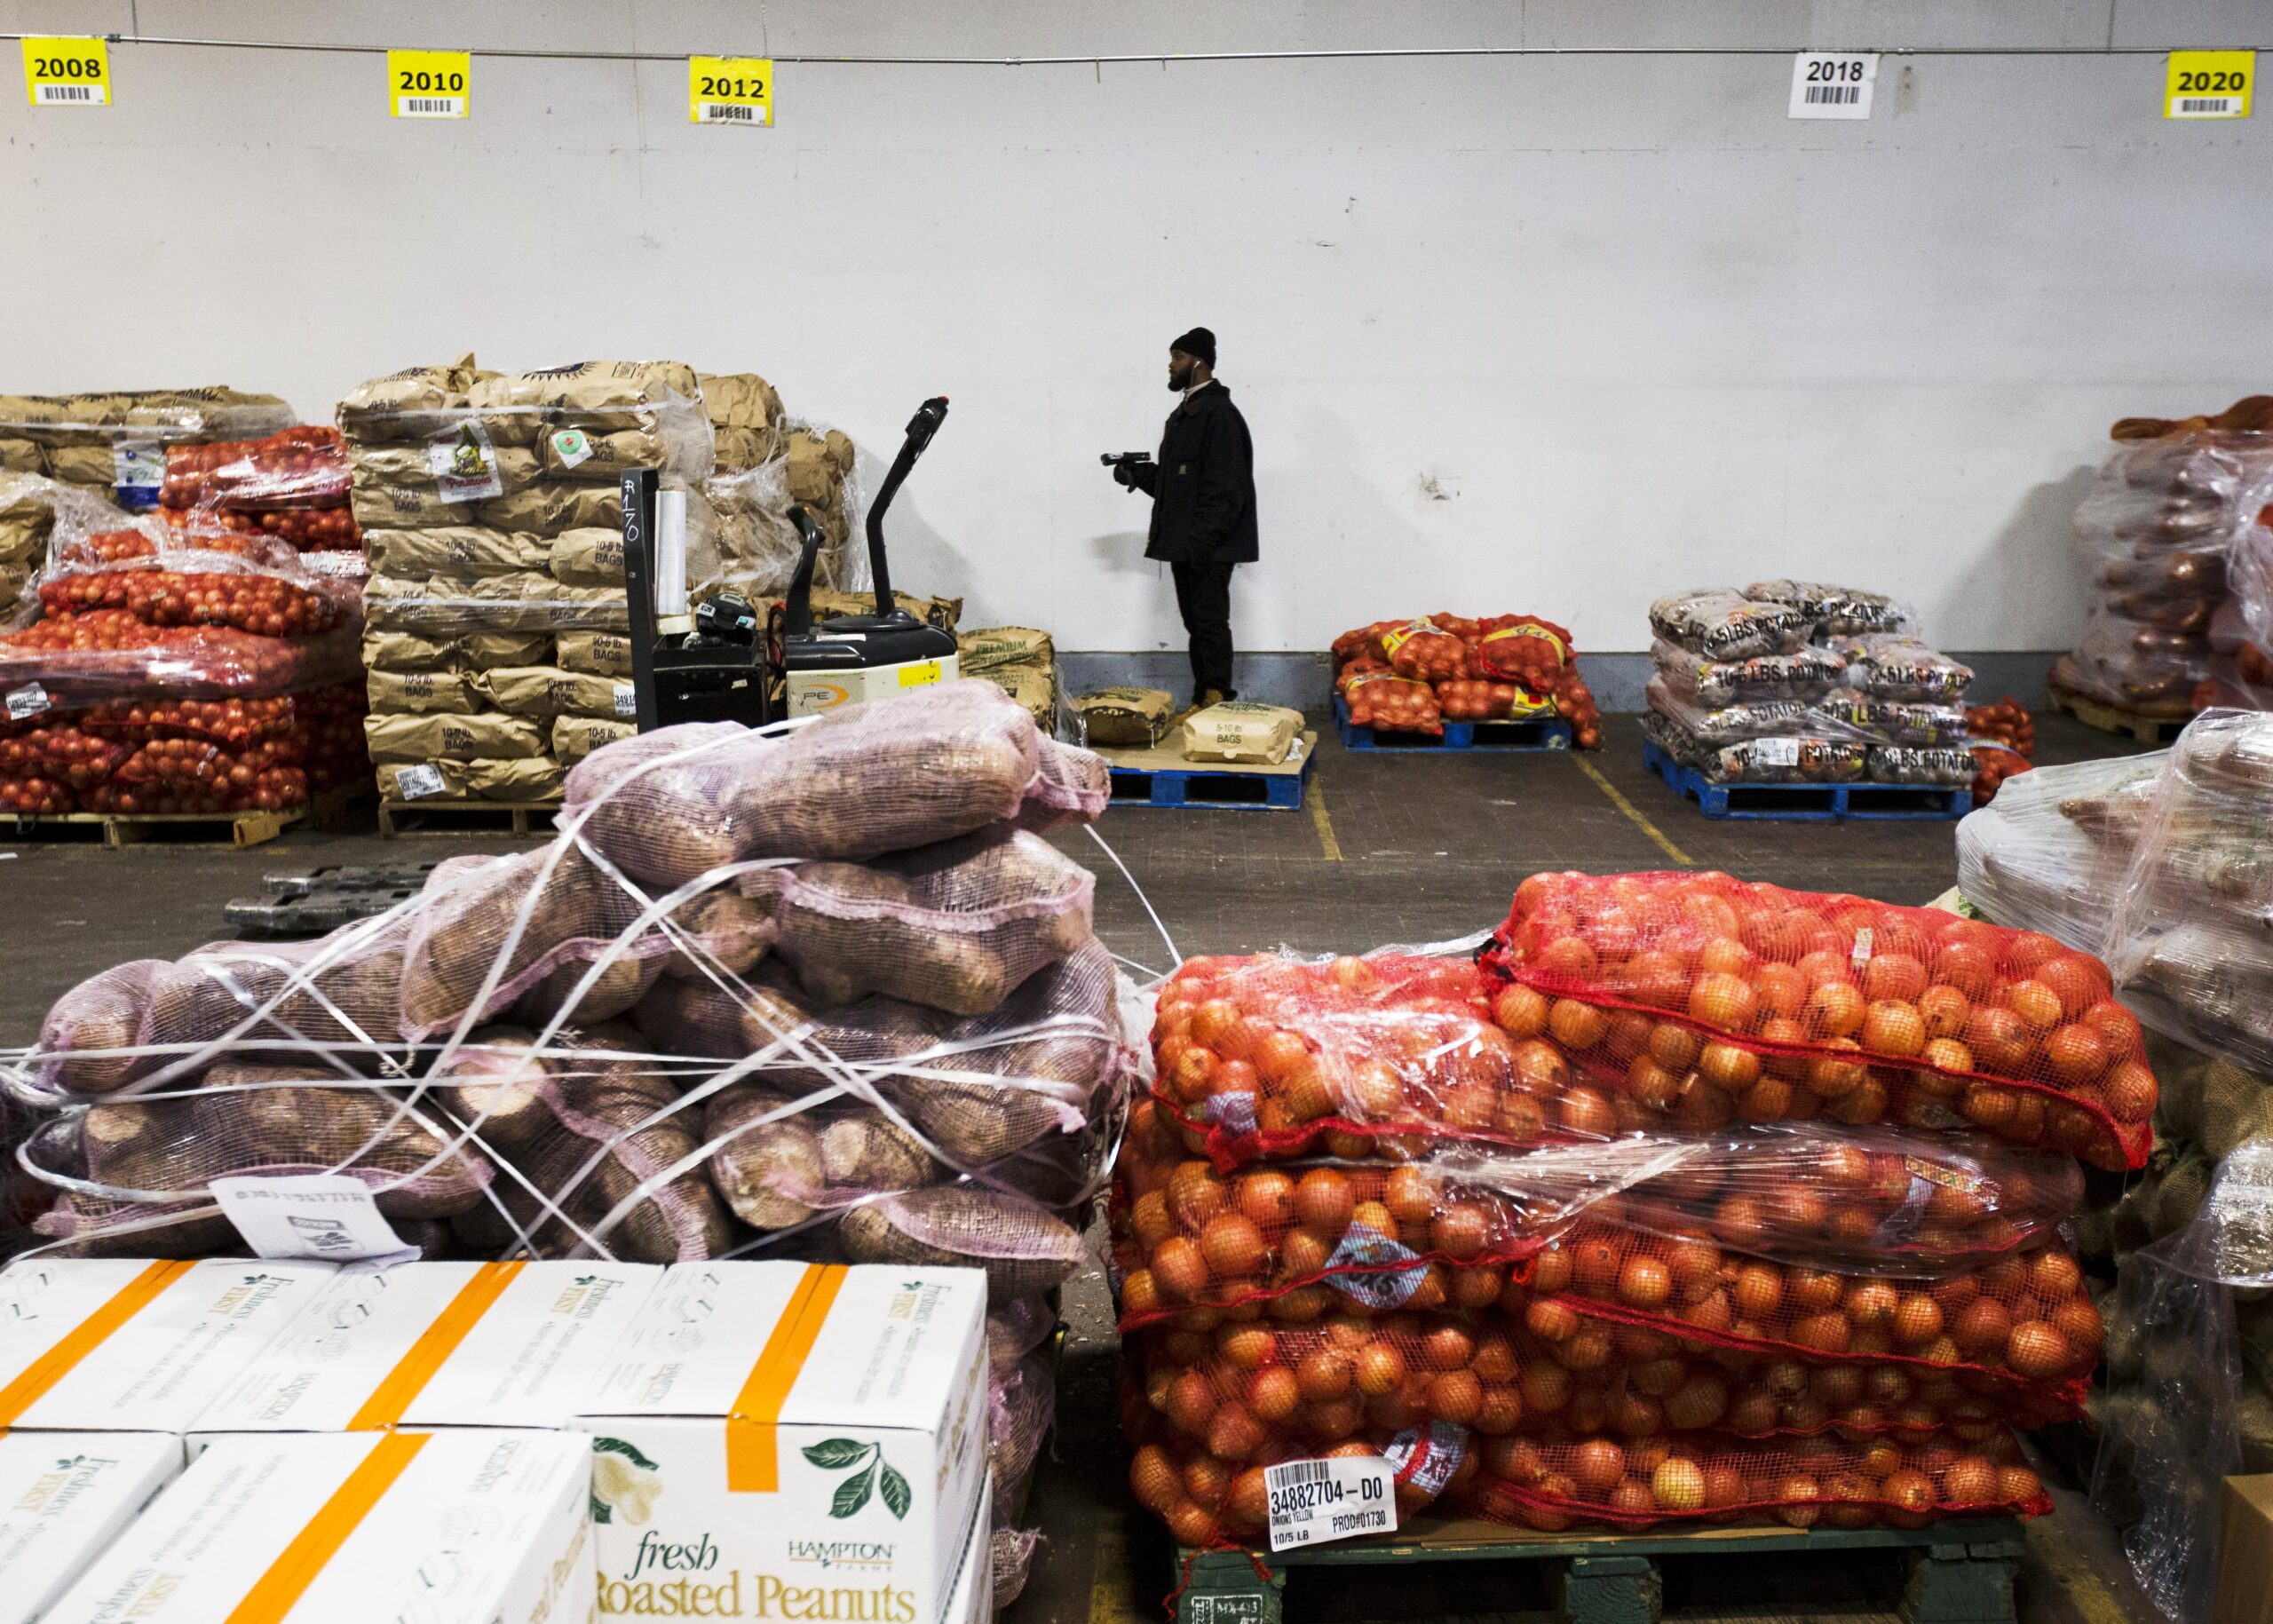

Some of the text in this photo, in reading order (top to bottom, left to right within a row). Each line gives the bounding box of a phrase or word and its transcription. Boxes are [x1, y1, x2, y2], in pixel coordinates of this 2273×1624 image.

[35, 58, 101, 78] 2008
[1806, 60, 1864, 82] 2018
[400, 71, 463, 91] 2010
[701, 76, 764, 98] 2012
[2177, 72, 2245, 91] 2020
[589, 451, 614, 462] AGS
[394, 500, 422, 512] BAGS
[596, 539, 614, 551] 10-5
[595, 552, 623, 566] BAGS
[593, 649, 622, 661] BAGS
[976, 640, 1027, 654] PREMIUM
[405, 673, 422, 685] 10-5
[1751, 664, 1786, 682] LBS.
[405, 685, 433, 697] BAGS
[588, 727, 619, 740] 10-5 lb.
[1216, 723, 1233, 733] 5-10
[445, 740, 474, 751] BAGS
[1217, 733, 1242, 744] BAGS
[209, 1287, 253, 1314] FIRST
[233, 1276, 295, 1319] Freshness
[550, 1287, 588, 1315] FIRST
[574, 1278, 624, 1319] Freshness
[888, 1292, 919, 1321] FIRST
[914, 1282, 952, 1325] Freshness
[644, 1362, 685, 1406] HAMPTON
[261, 1373, 321, 1421] HAMPTON
[12, 1473, 69, 1512] FIRST
[39, 1457, 120, 1517] Freshness
[1271, 1509, 1314, 1527] ONIONS YELLOW
[1332, 1509, 1386, 1534] PROD#01730
[1273, 1529, 1310, 1546] 10/5 LB
[624, 1529, 718, 1580] fresh
[788, 1540, 893, 1560] HAMPTON
[125, 1573, 187, 1617] FIRST
[755, 1574, 916, 1624] Peanuts
